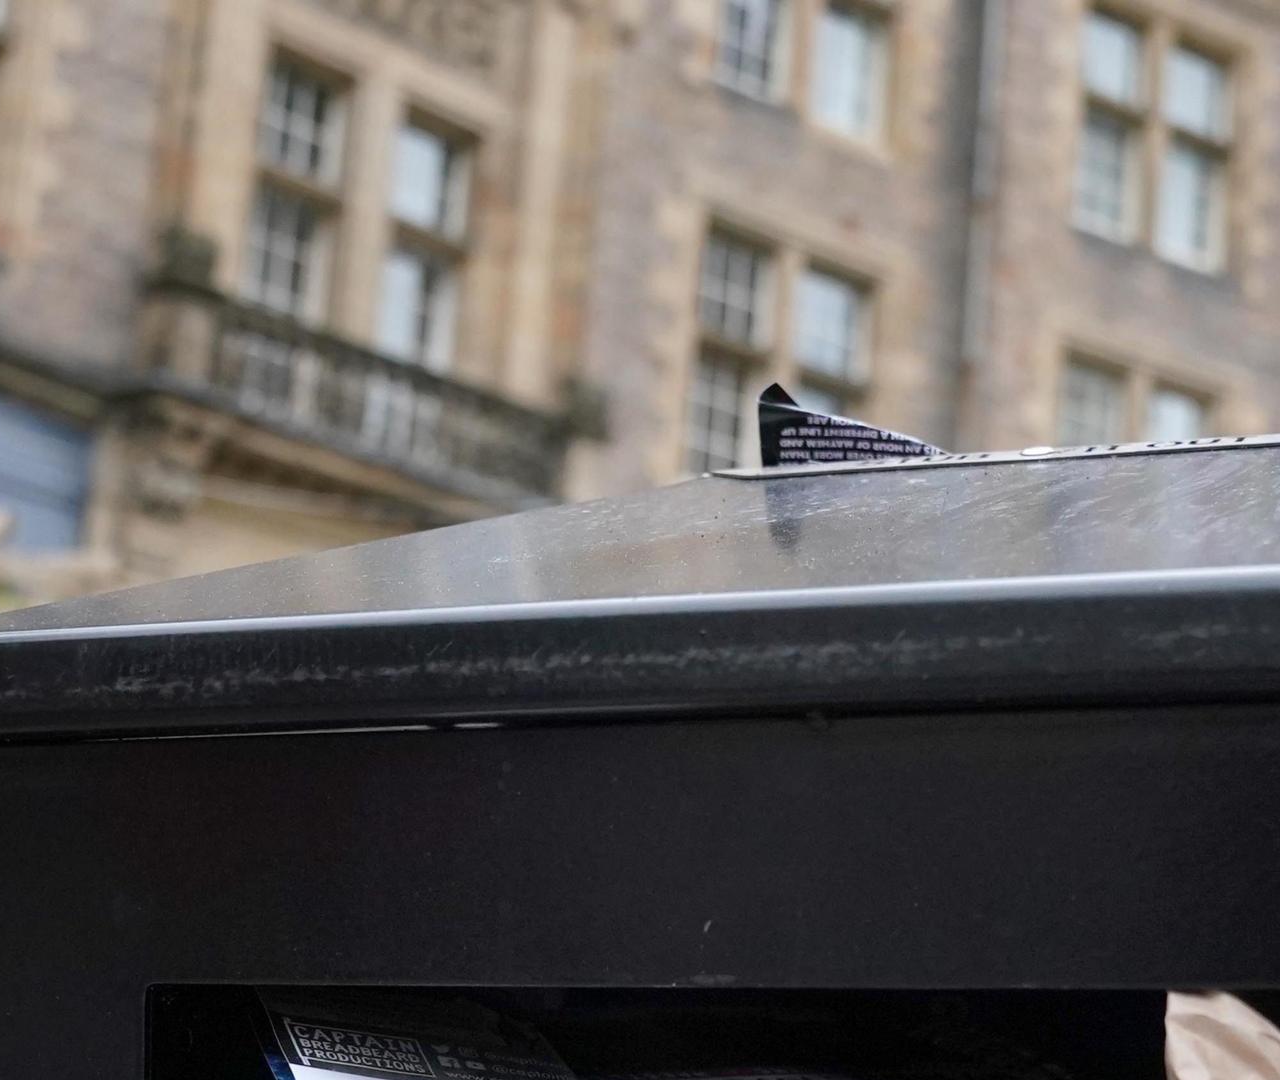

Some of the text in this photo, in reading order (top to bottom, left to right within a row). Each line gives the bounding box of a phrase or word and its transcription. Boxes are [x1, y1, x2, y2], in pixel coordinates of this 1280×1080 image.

[823, 428, 879, 439] DIFFERENT
[779, 439, 802, 448] AND
[872, 442, 904, 451] HOUR
[780, 451, 810, 460] THAN
[294, 1026, 417, 1053] CAPTAIN
[299, 1039, 419, 1063] BREADBEARD
[303, 1049, 426, 1073] PRODUCTIONS
